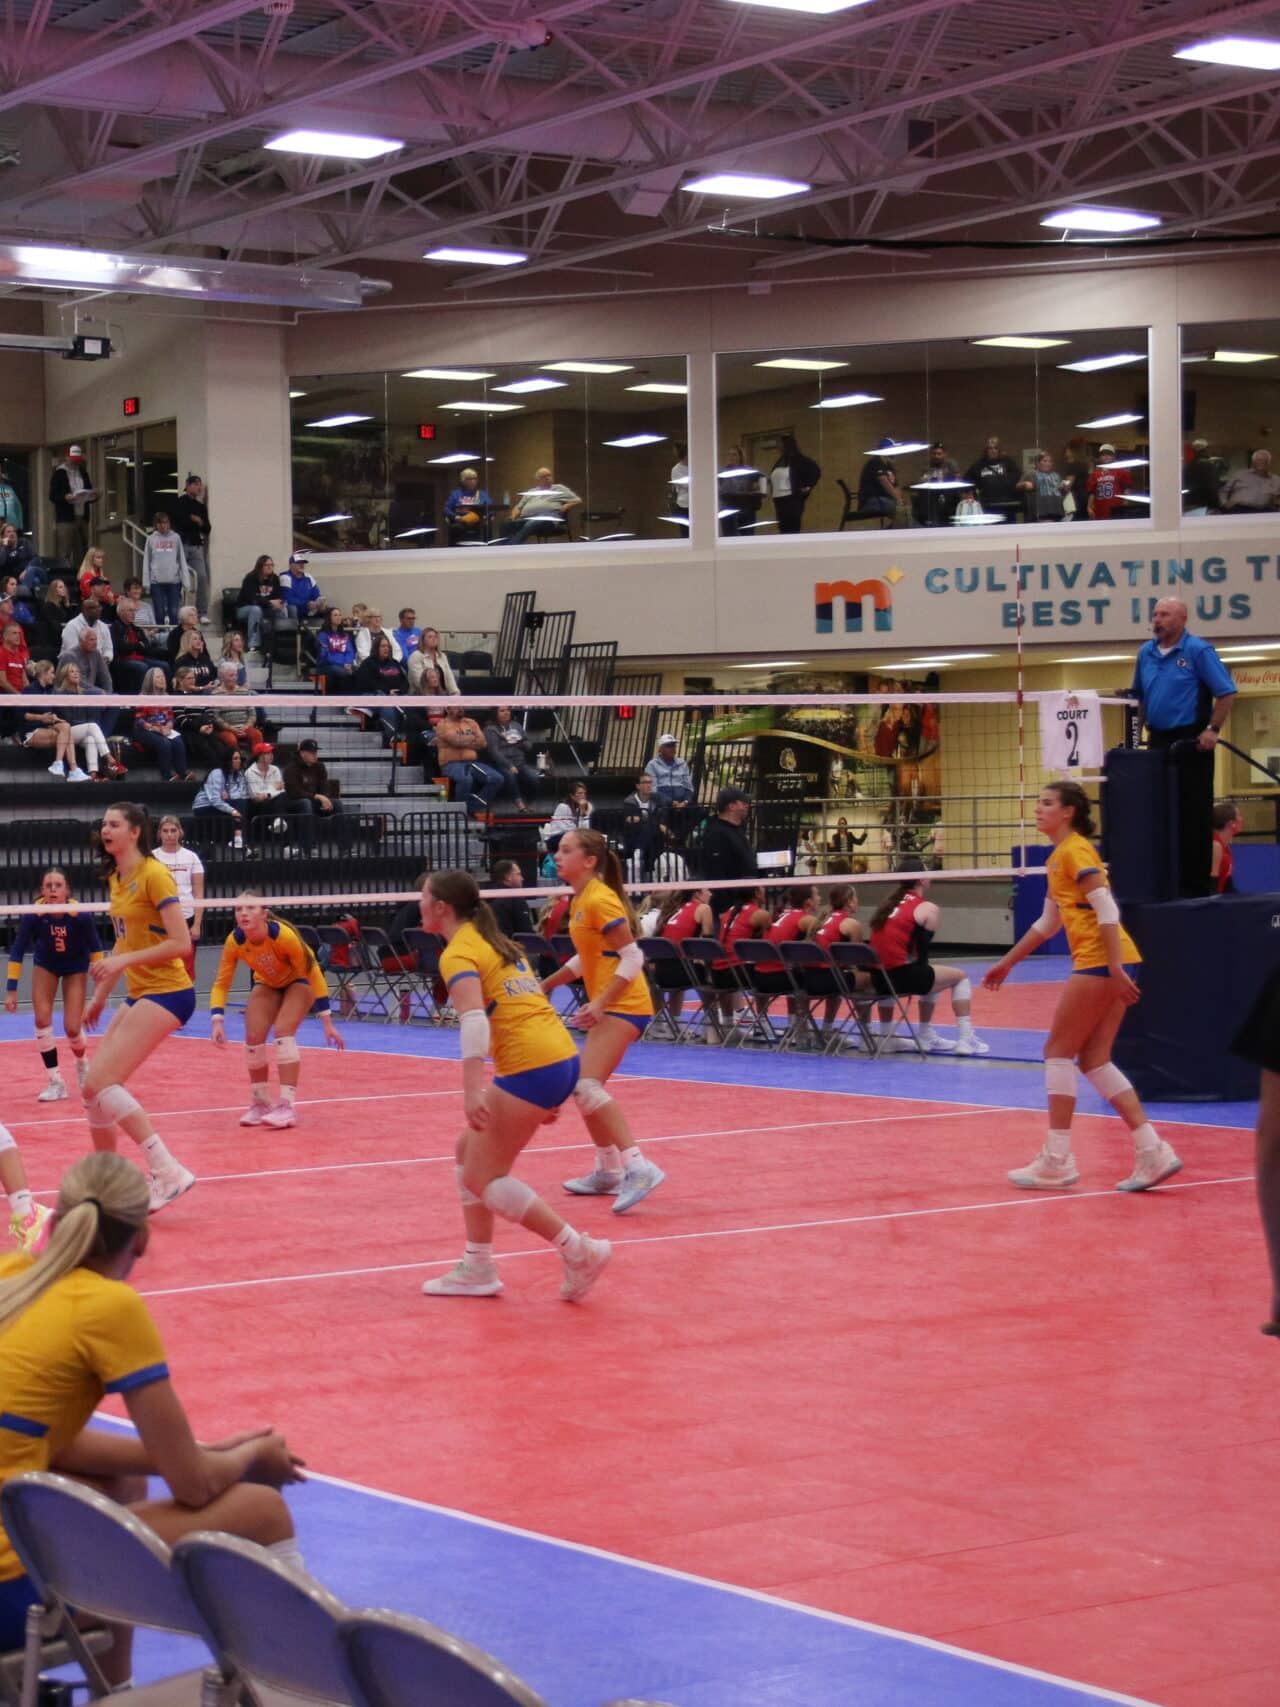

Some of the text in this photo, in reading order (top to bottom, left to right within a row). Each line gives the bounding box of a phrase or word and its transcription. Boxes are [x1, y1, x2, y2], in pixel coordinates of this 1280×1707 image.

[924, 555, 1228, 595] CULTIVATING
[1002, 598, 1111, 629] BEST
[1196, 593, 1251, 621] US
[1056, 709, 1089, 721] COURT
[1065, 721, 1080, 767] 2
